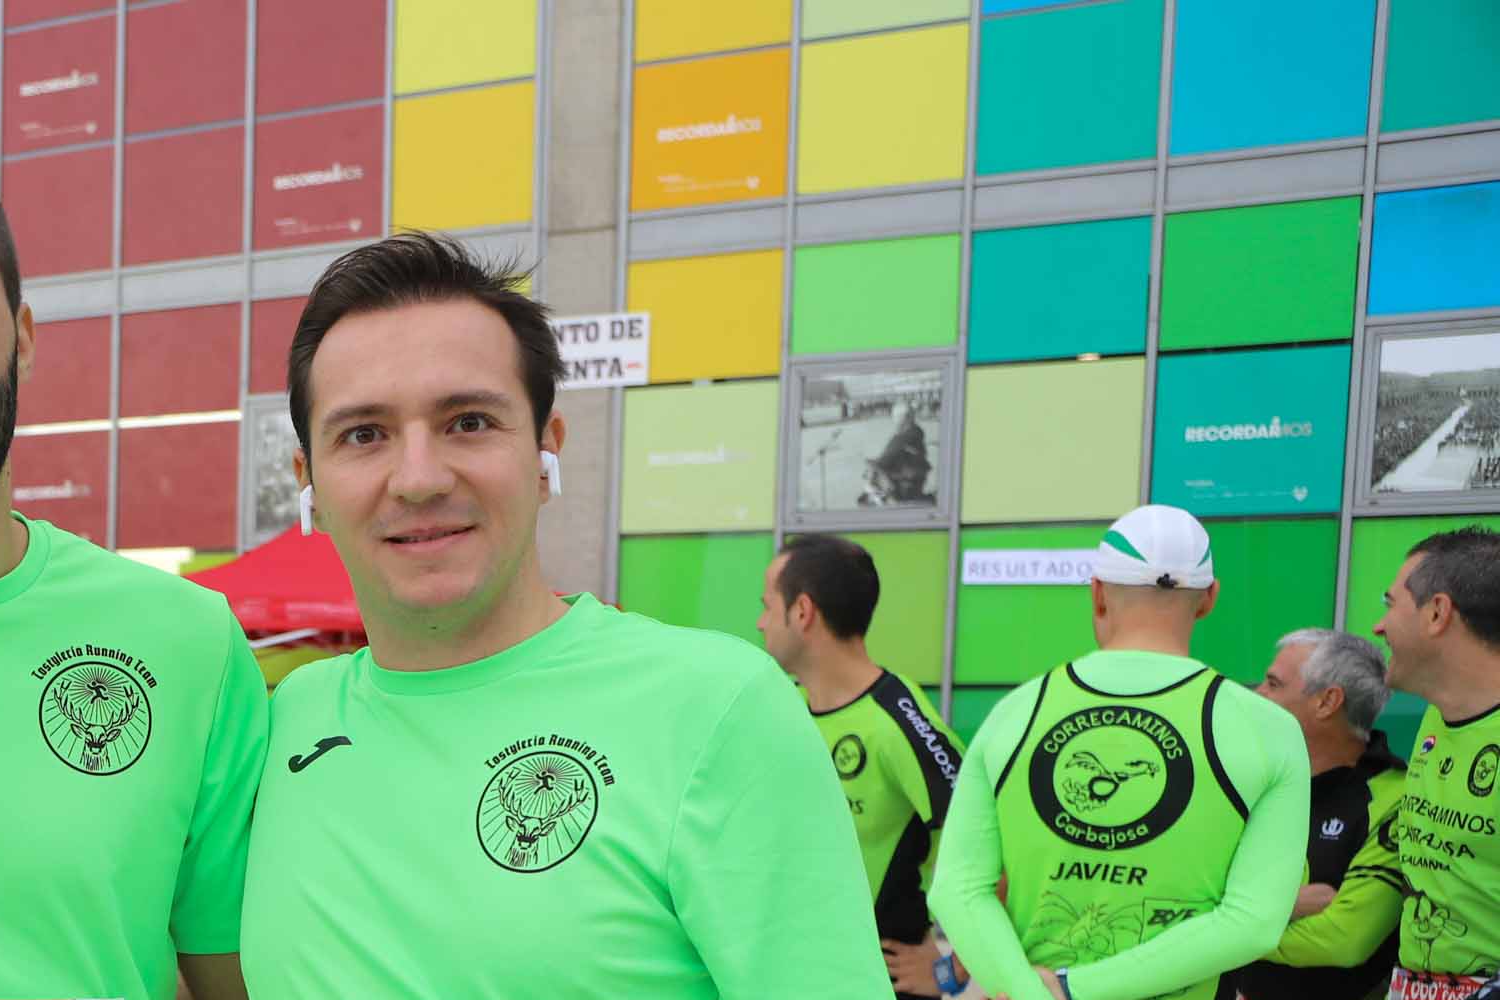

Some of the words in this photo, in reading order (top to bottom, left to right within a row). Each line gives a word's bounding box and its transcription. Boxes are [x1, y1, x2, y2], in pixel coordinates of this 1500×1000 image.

[611, 318, 642, 340] DE
[85, 643, 134, 668] Running
[133, 659, 158, 689] Team
[1043, 709, 1184, 760] CORRECAMINOS
[549, 733, 598, 761] Running
[594, 754, 616, 787] Team
[1054, 812, 1149, 850] Carbajosa
[1048, 861, 1149, 887] JAVIER
